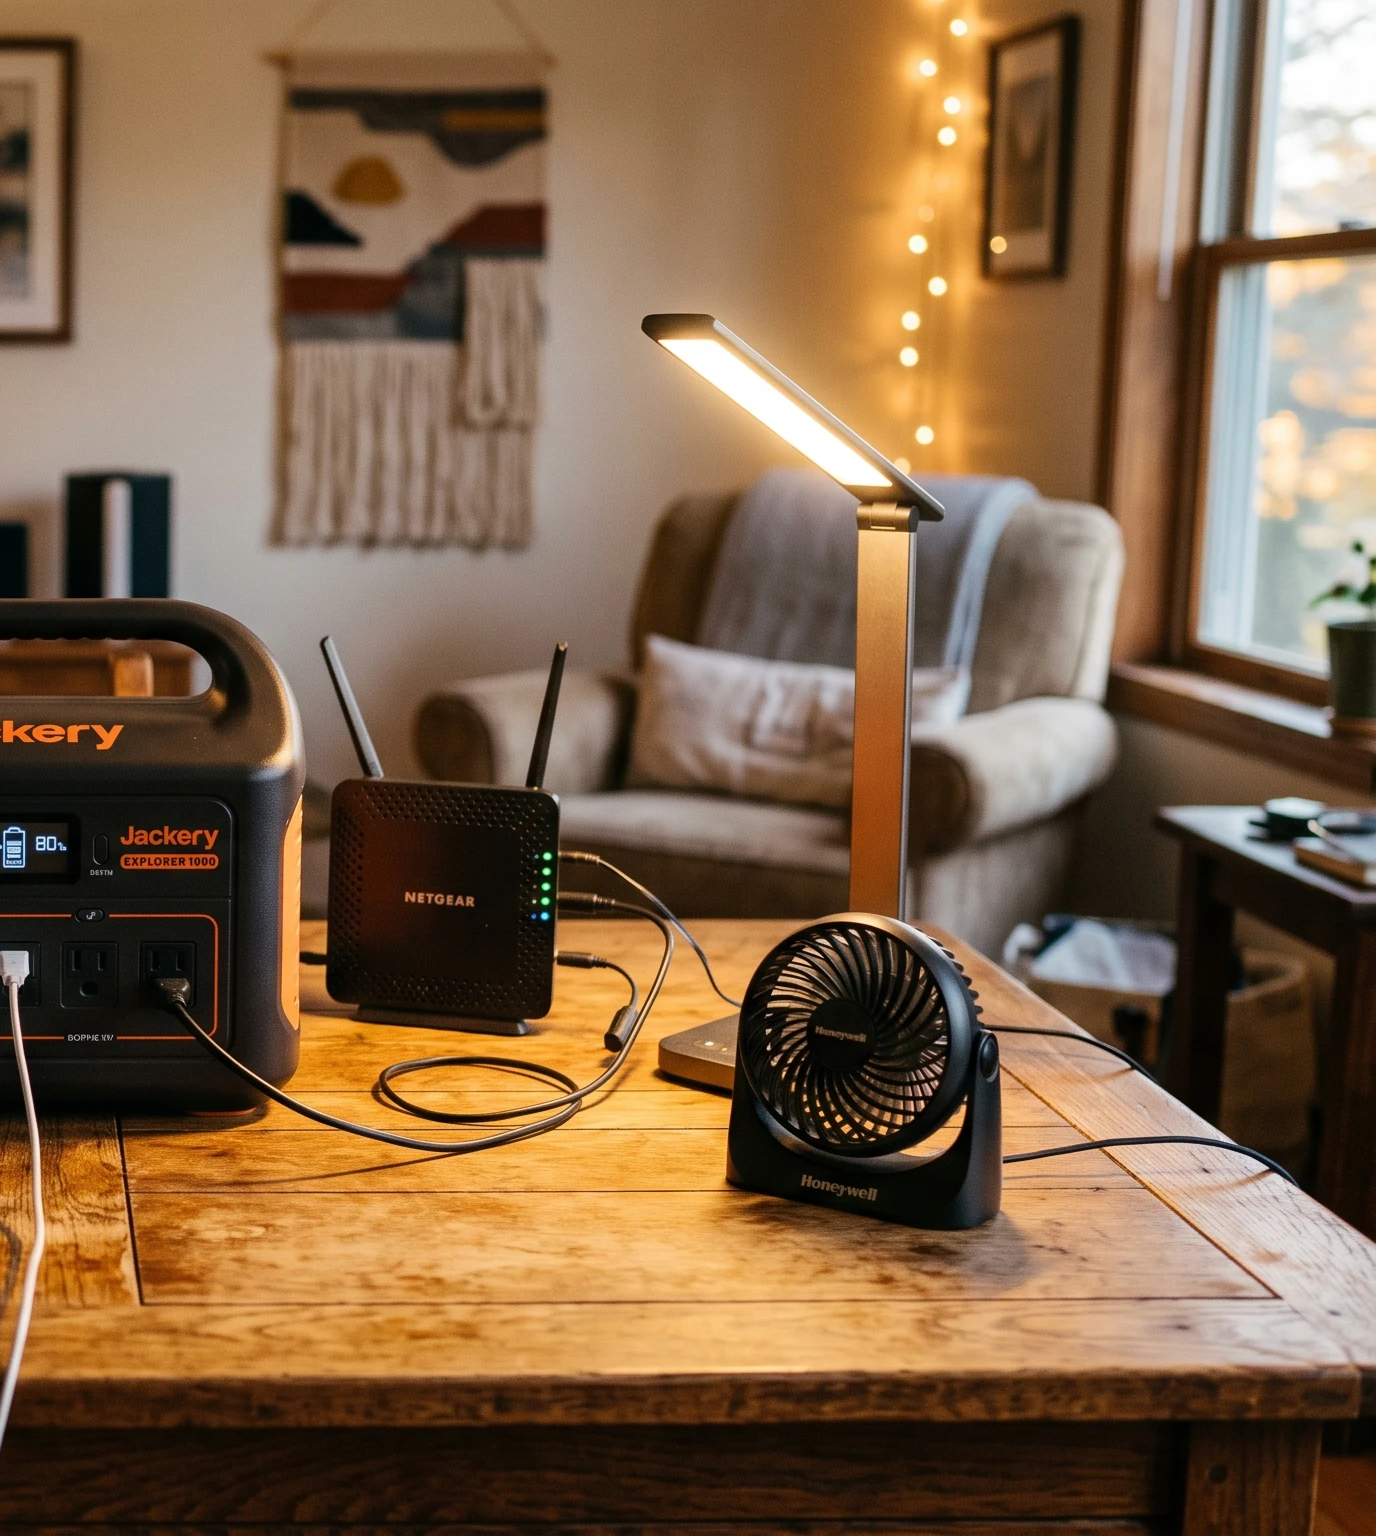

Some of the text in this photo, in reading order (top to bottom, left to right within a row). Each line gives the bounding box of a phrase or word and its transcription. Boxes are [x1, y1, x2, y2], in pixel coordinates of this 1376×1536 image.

[120, 825, 219, 850] Jackery
[124, 857, 216, 866] EXPLORER 1000
[404, 891, 475, 907] NETGEAR
[800, 1174, 878, 1202] Honeywell
